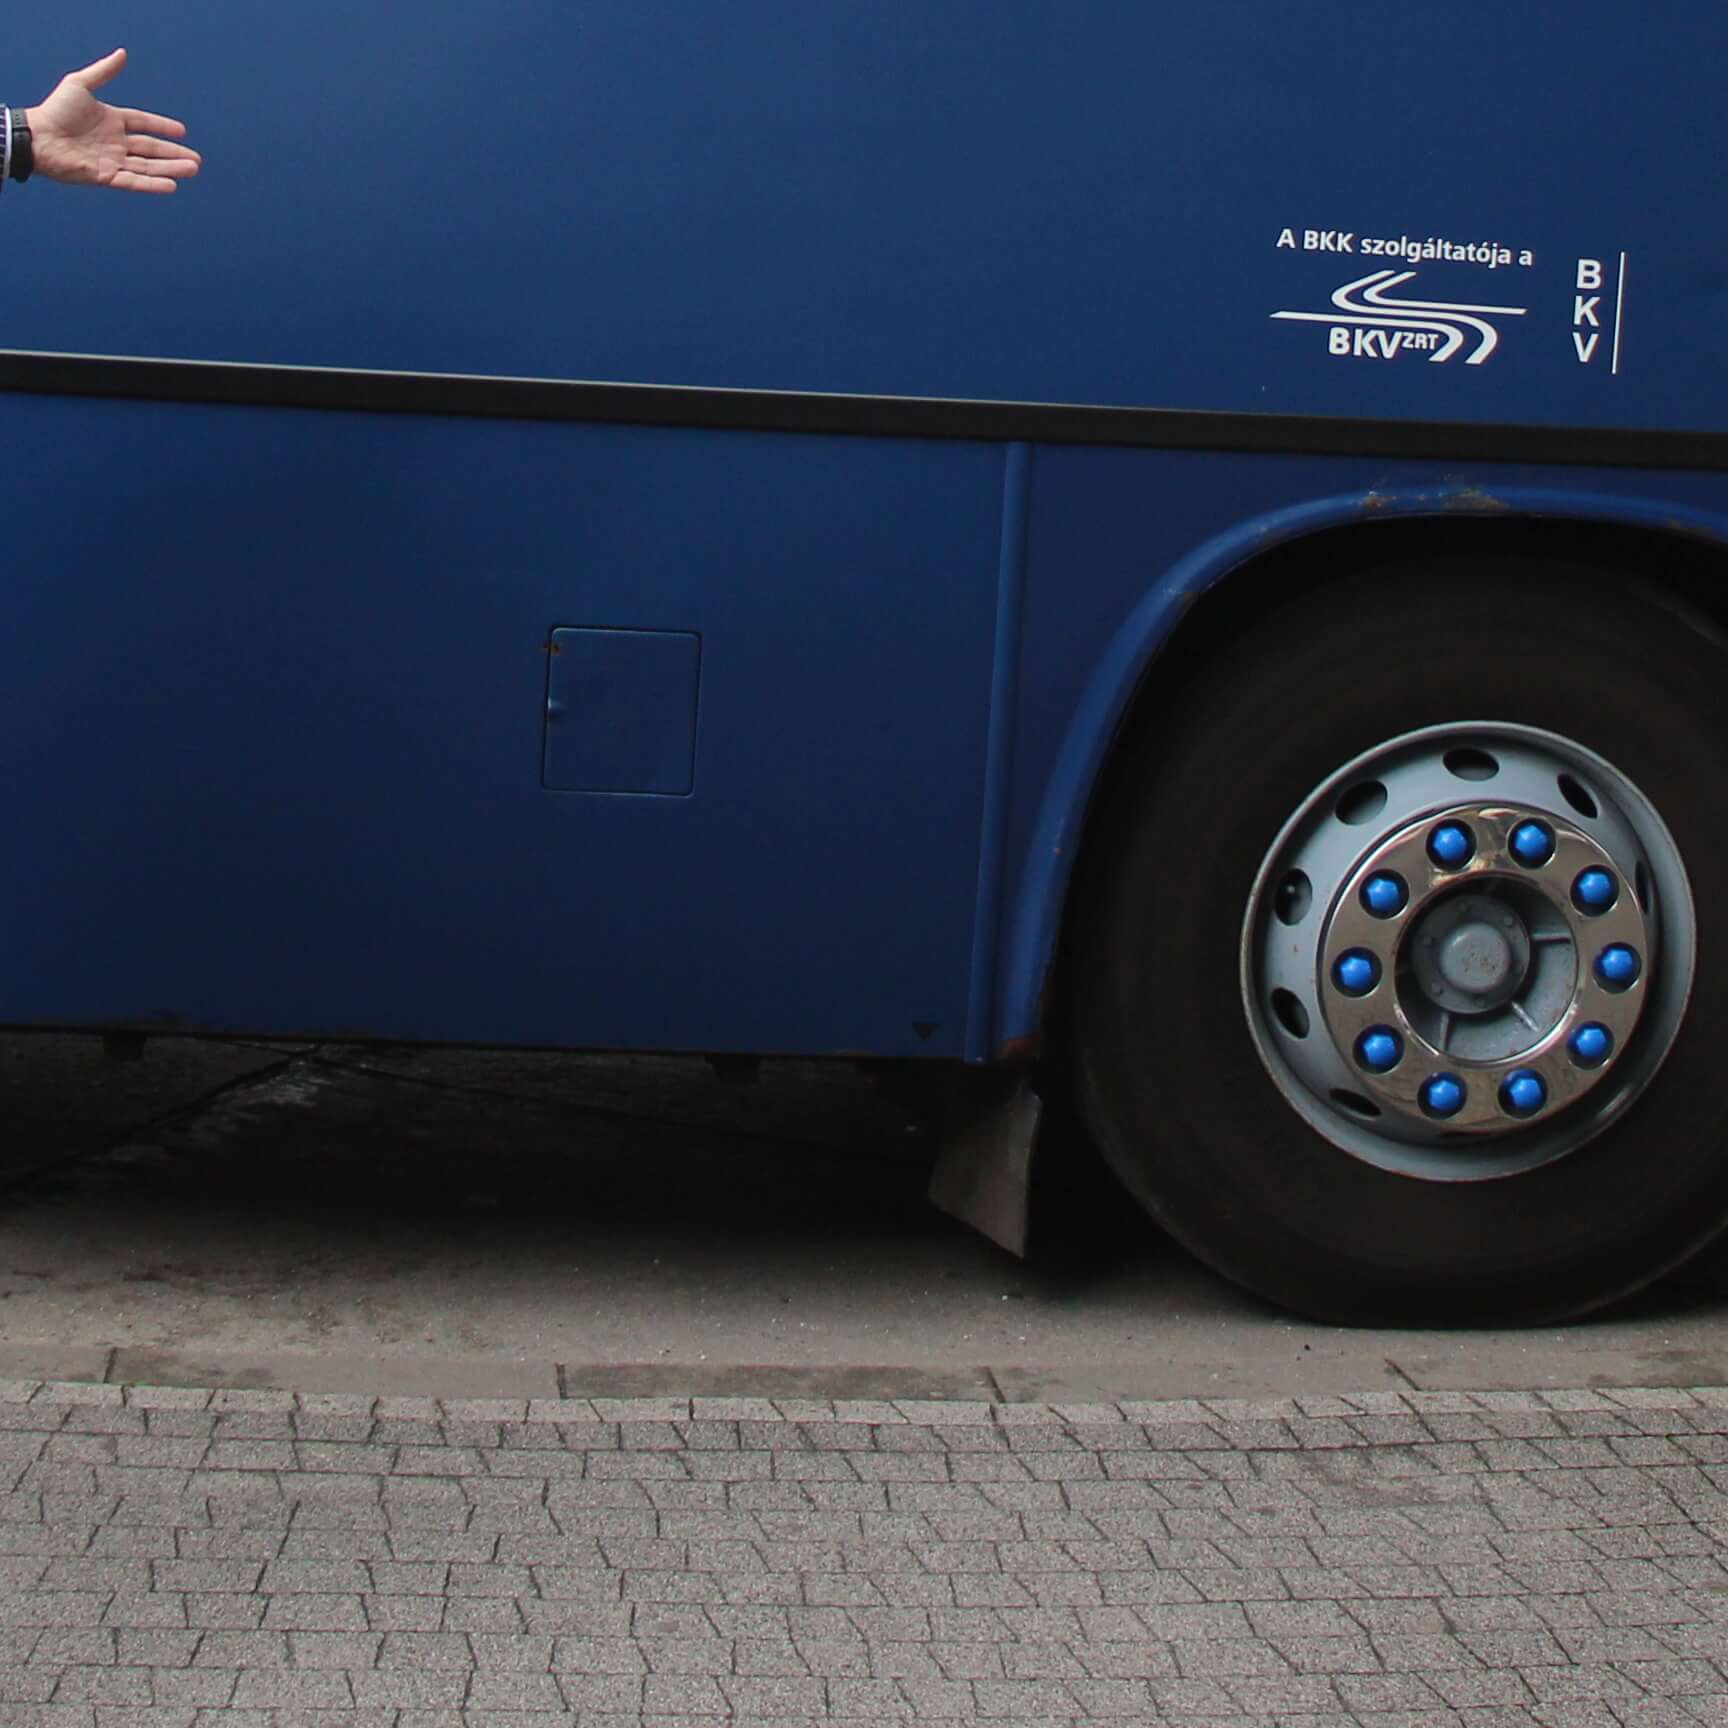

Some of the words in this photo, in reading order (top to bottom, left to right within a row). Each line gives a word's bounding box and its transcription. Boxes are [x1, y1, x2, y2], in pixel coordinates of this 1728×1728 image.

[1276, 228, 1296, 249] A
[1303, 230, 1354, 255] BKK
[1359, 234, 1512, 269] szolgáltatója
[1518, 247, 1534, 267] a
[1328, 327, 1404, 359] BKV
[1402, 331, 1439, 351] ZRT
